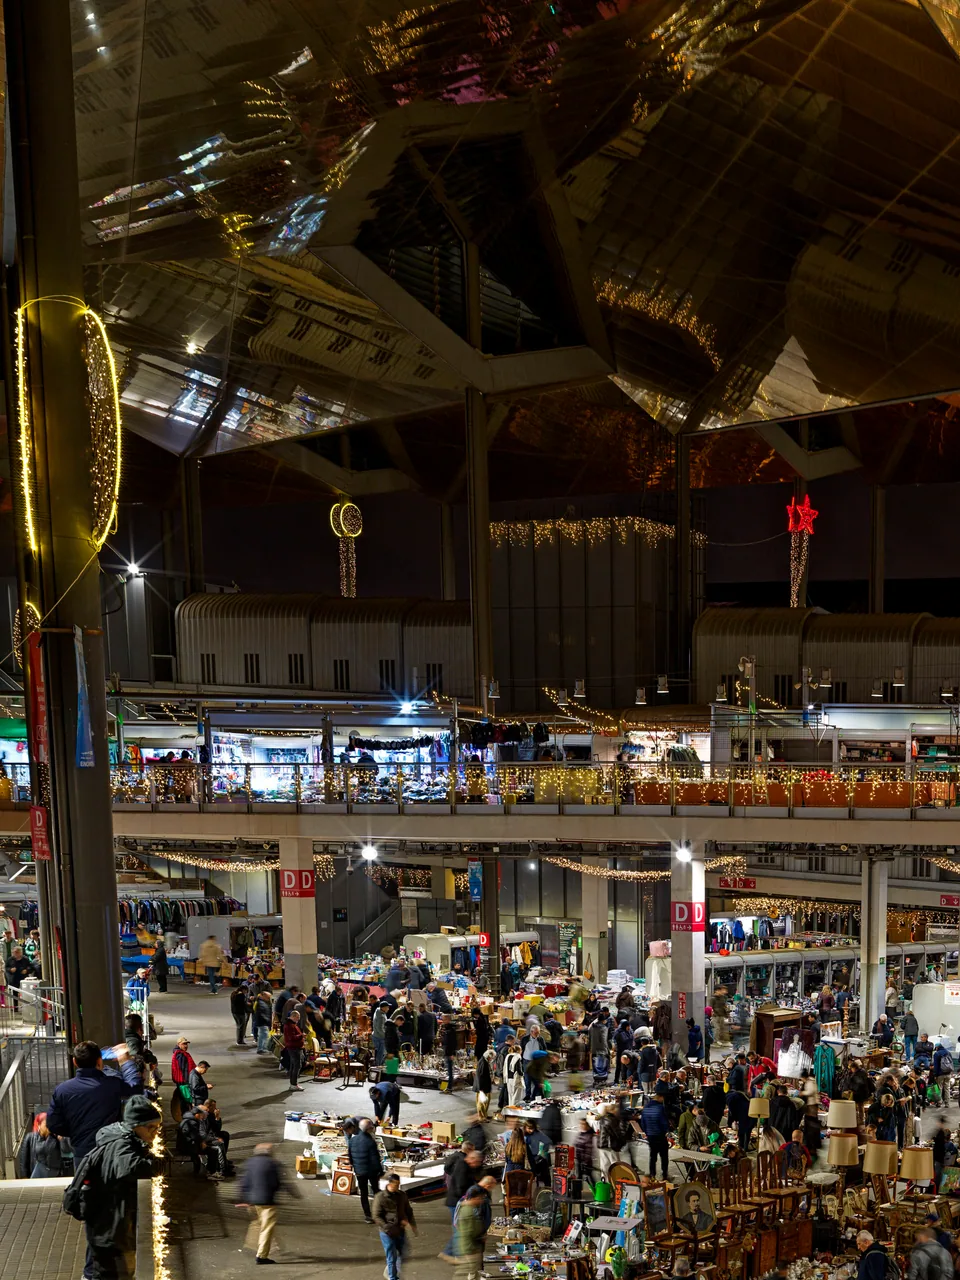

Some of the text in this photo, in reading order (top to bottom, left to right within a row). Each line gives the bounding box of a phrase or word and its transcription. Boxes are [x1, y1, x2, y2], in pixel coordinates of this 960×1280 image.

[35, 811, 43, 826] D
[283, 871, 296, 889] D
[302, 871, 312, 889] D
[675, 903, 689, 922] D
[695, 903, 703, 922] D
[480, 934, 487, 945] D
